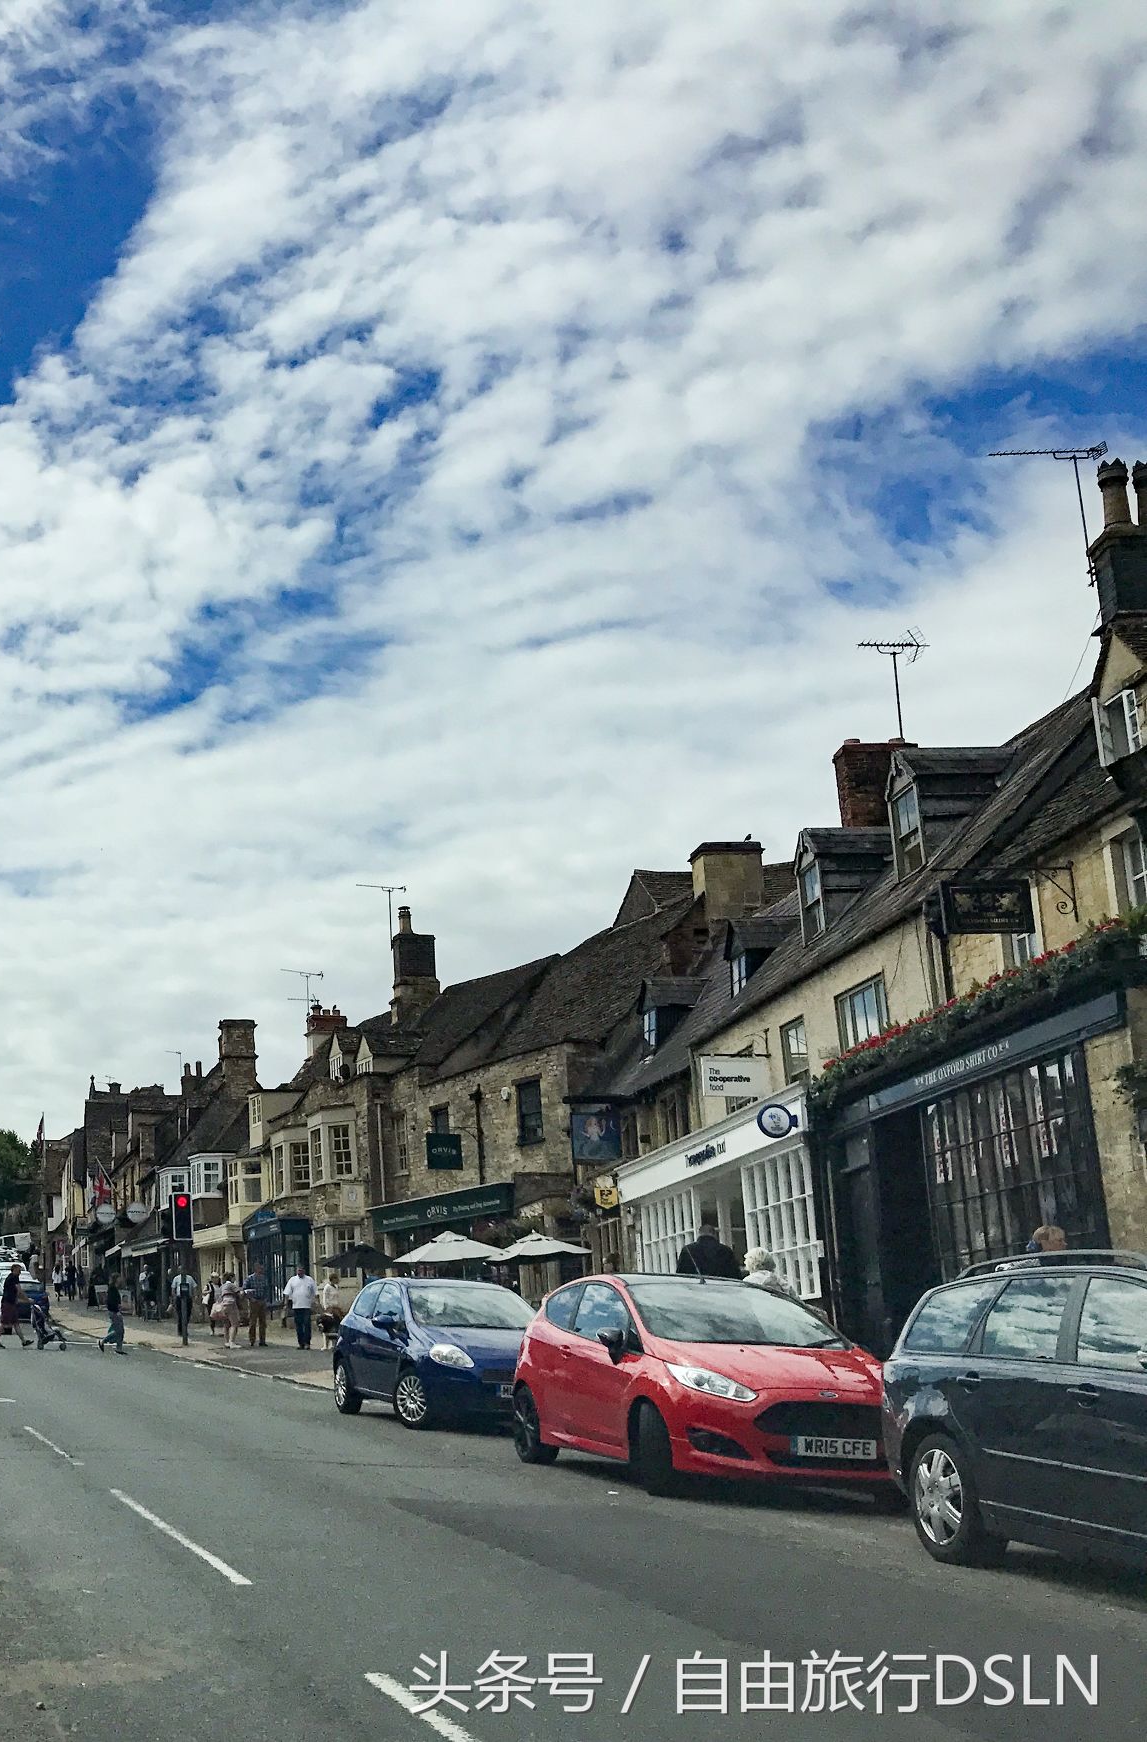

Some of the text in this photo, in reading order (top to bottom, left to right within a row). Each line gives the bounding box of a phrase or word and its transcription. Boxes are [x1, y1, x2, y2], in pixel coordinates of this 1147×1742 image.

[925, 1073, 937, 1086] THE
[938, 1059, 965, 1080] OXFORD
[965, 1048, 987, 1069] SHIRT
[987, 1044, 998, 1060] CO
[709, 1075, 750, 1083] co-operative
[432, 1147, 457, 1155] ORVIS
[426, 1204, 448, 1218] ORVIS
[804, 1438, 871, 1456] WR15 CFE
